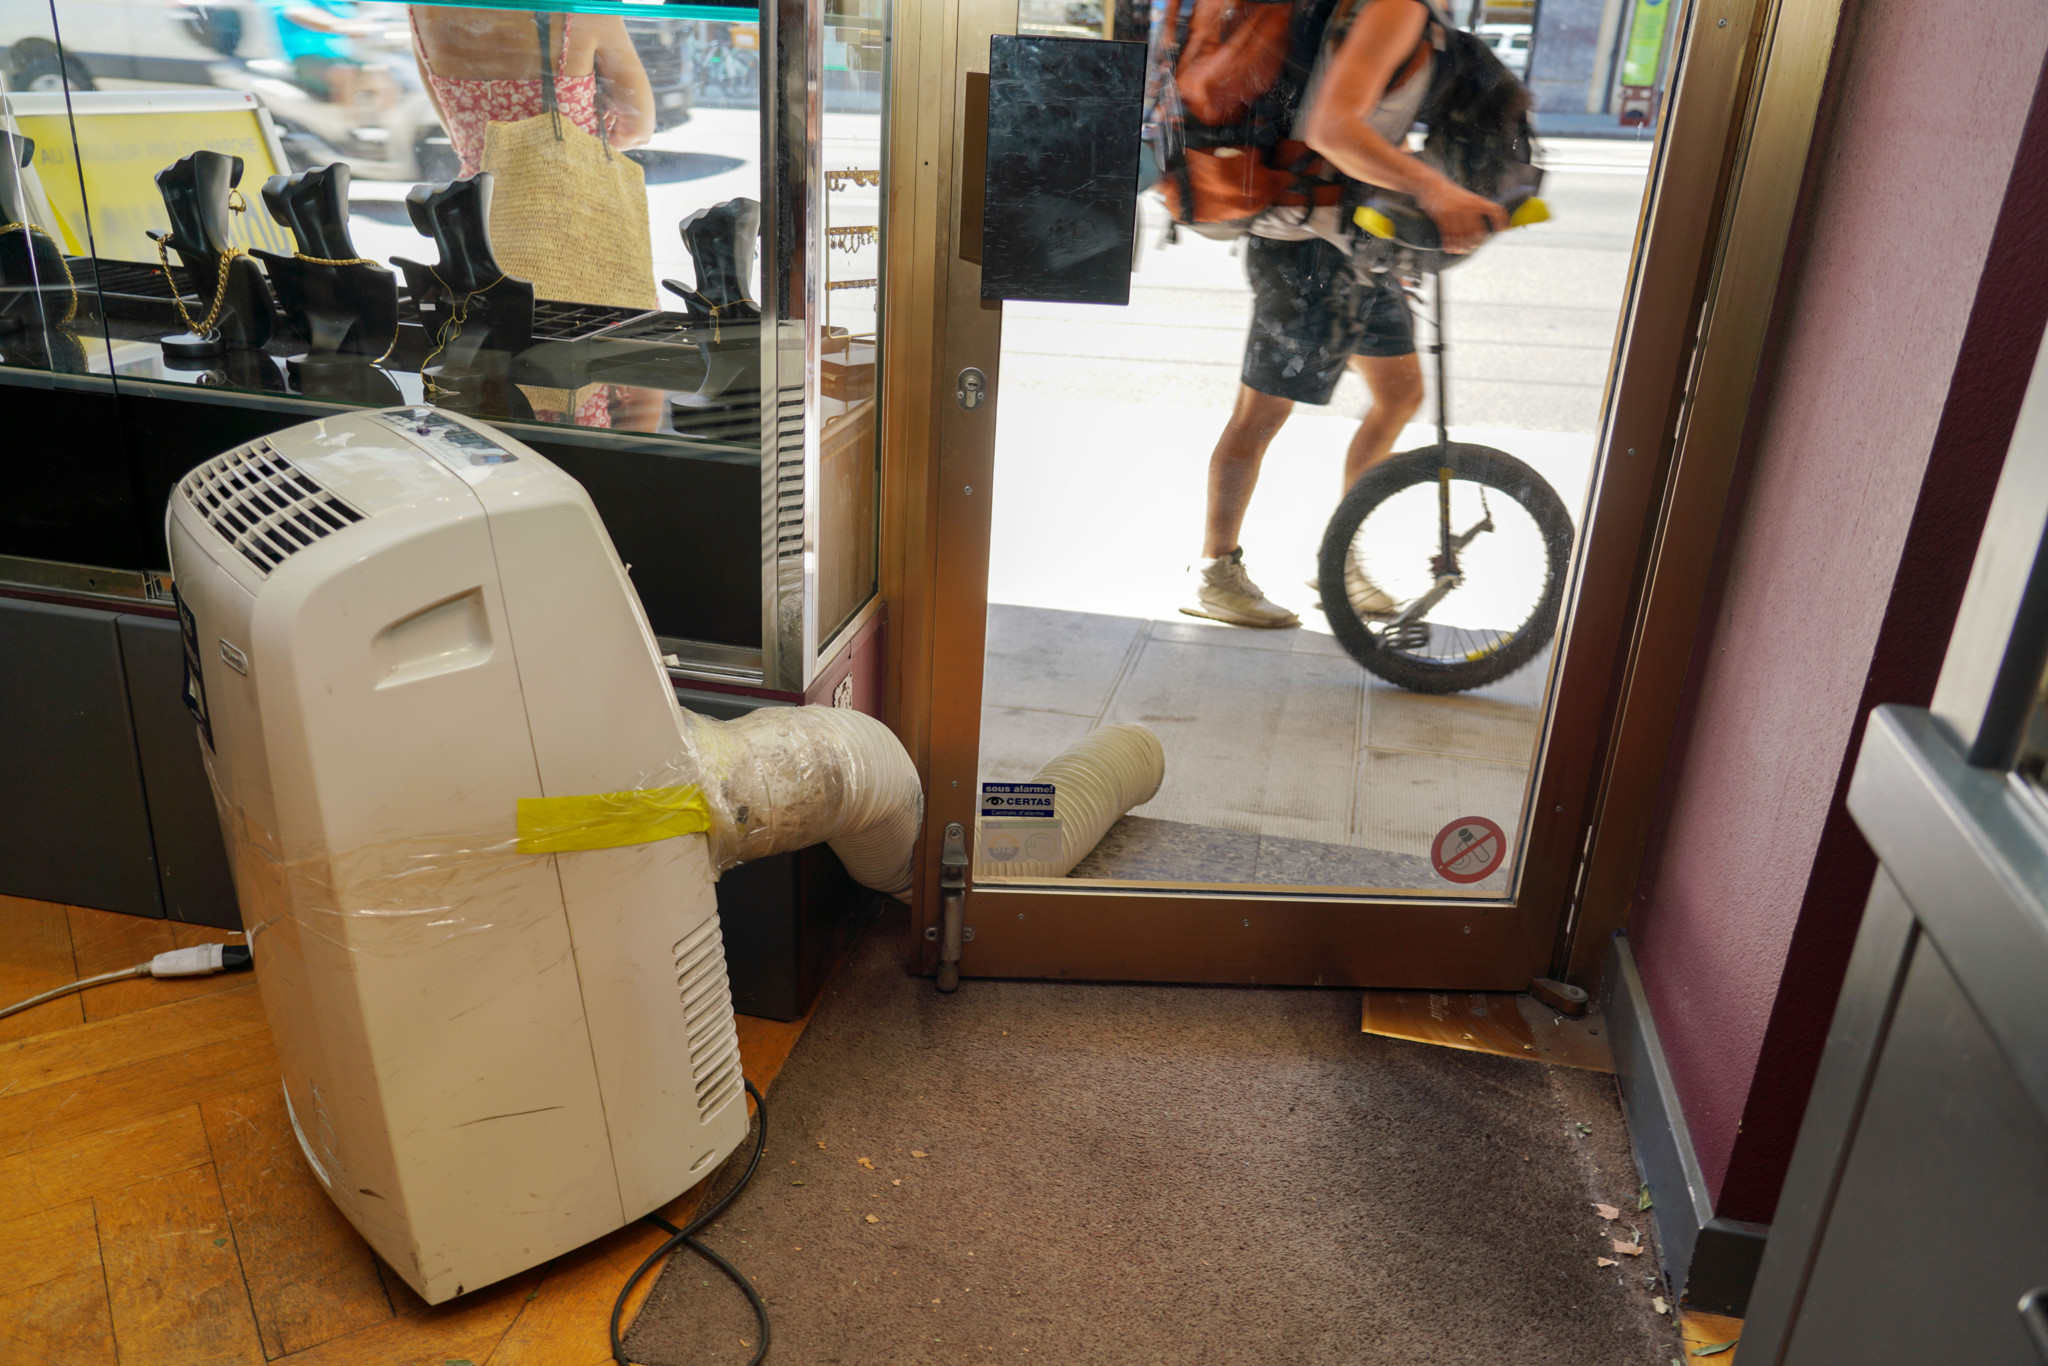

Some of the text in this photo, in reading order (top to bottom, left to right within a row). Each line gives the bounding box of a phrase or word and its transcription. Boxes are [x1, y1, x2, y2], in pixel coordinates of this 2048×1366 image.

[41, 147, 64, 165] AU
[985, 784, 1053, 793] sous alarme!
[1006, 797, 1051, 806] CERTAS
